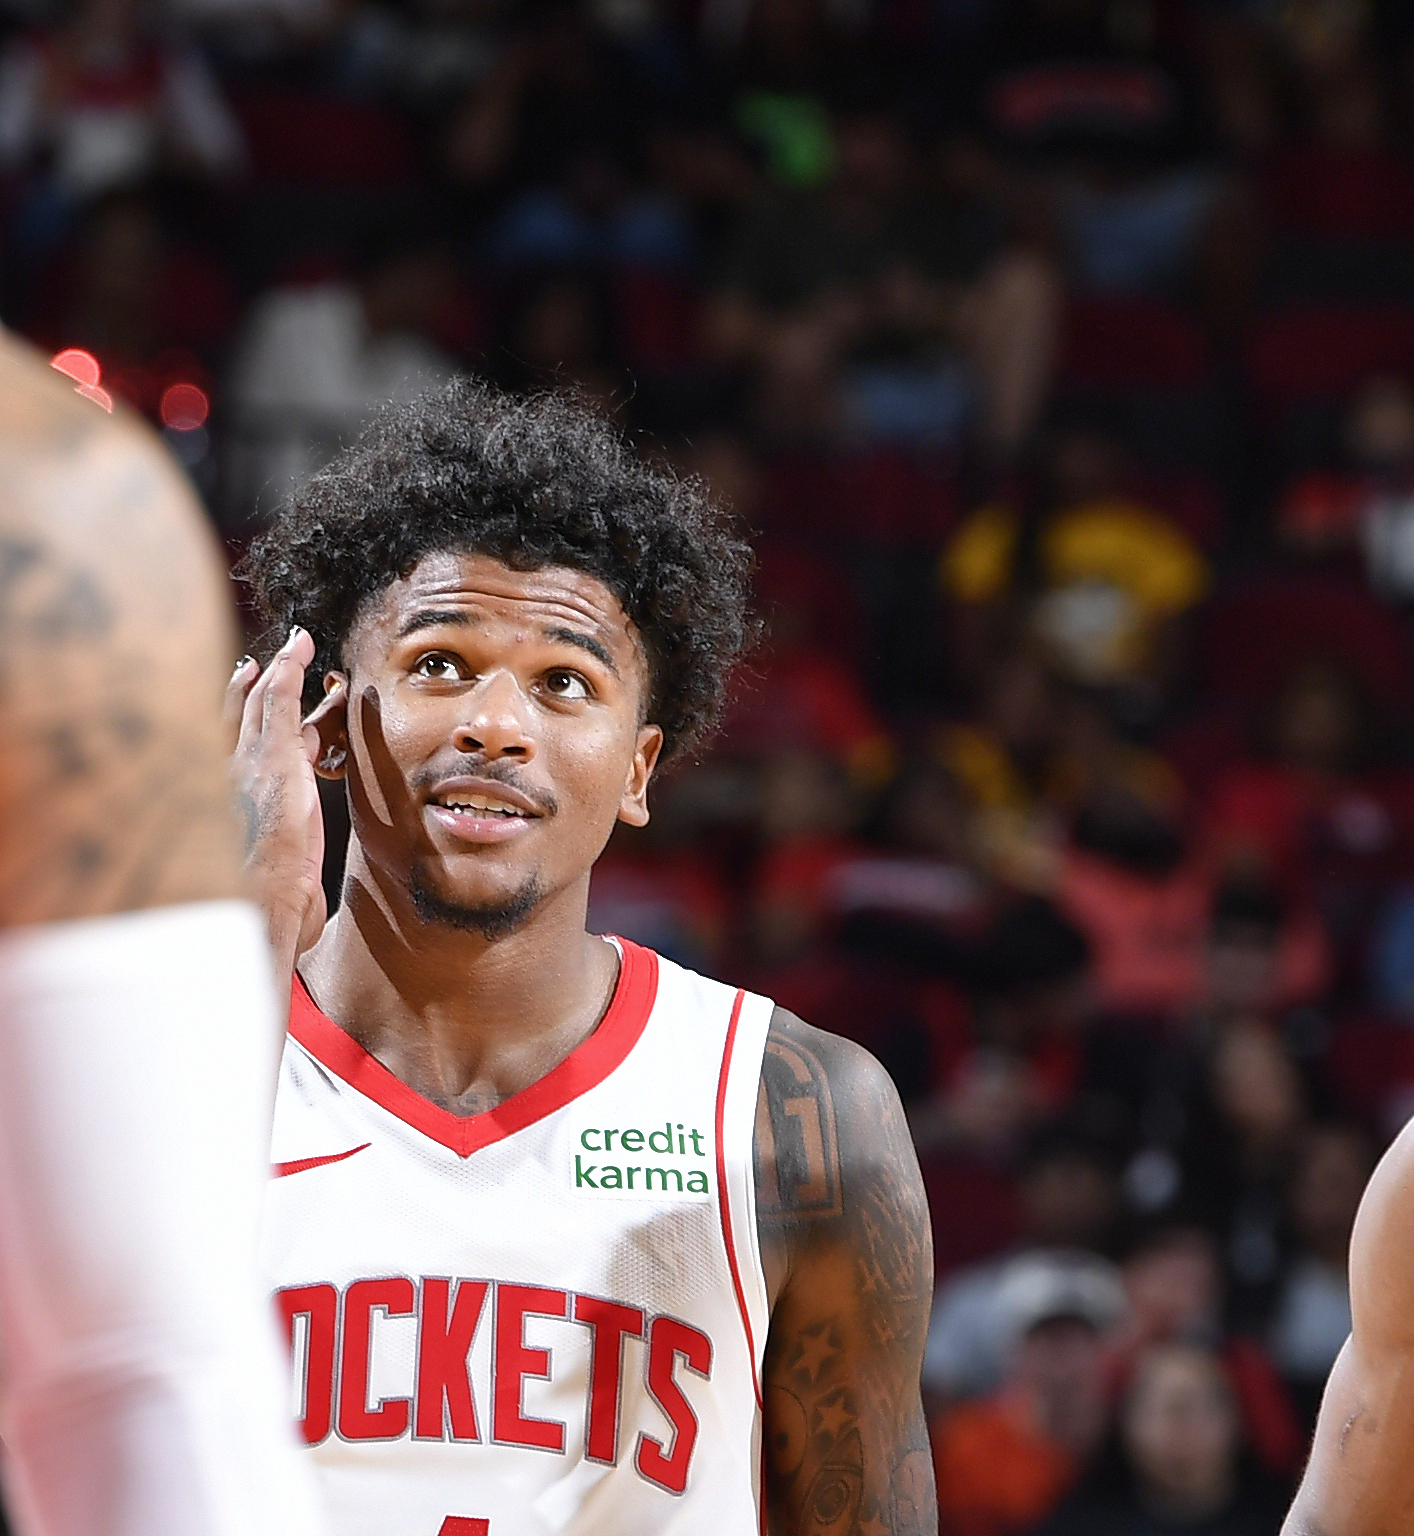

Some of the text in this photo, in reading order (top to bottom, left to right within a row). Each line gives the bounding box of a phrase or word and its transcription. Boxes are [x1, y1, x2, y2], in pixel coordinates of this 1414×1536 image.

[580, 1122, 706, 1157] credit
[574, 1154, 709, 1194] karma
[271, 1274, 715, 1497] OCKETS
